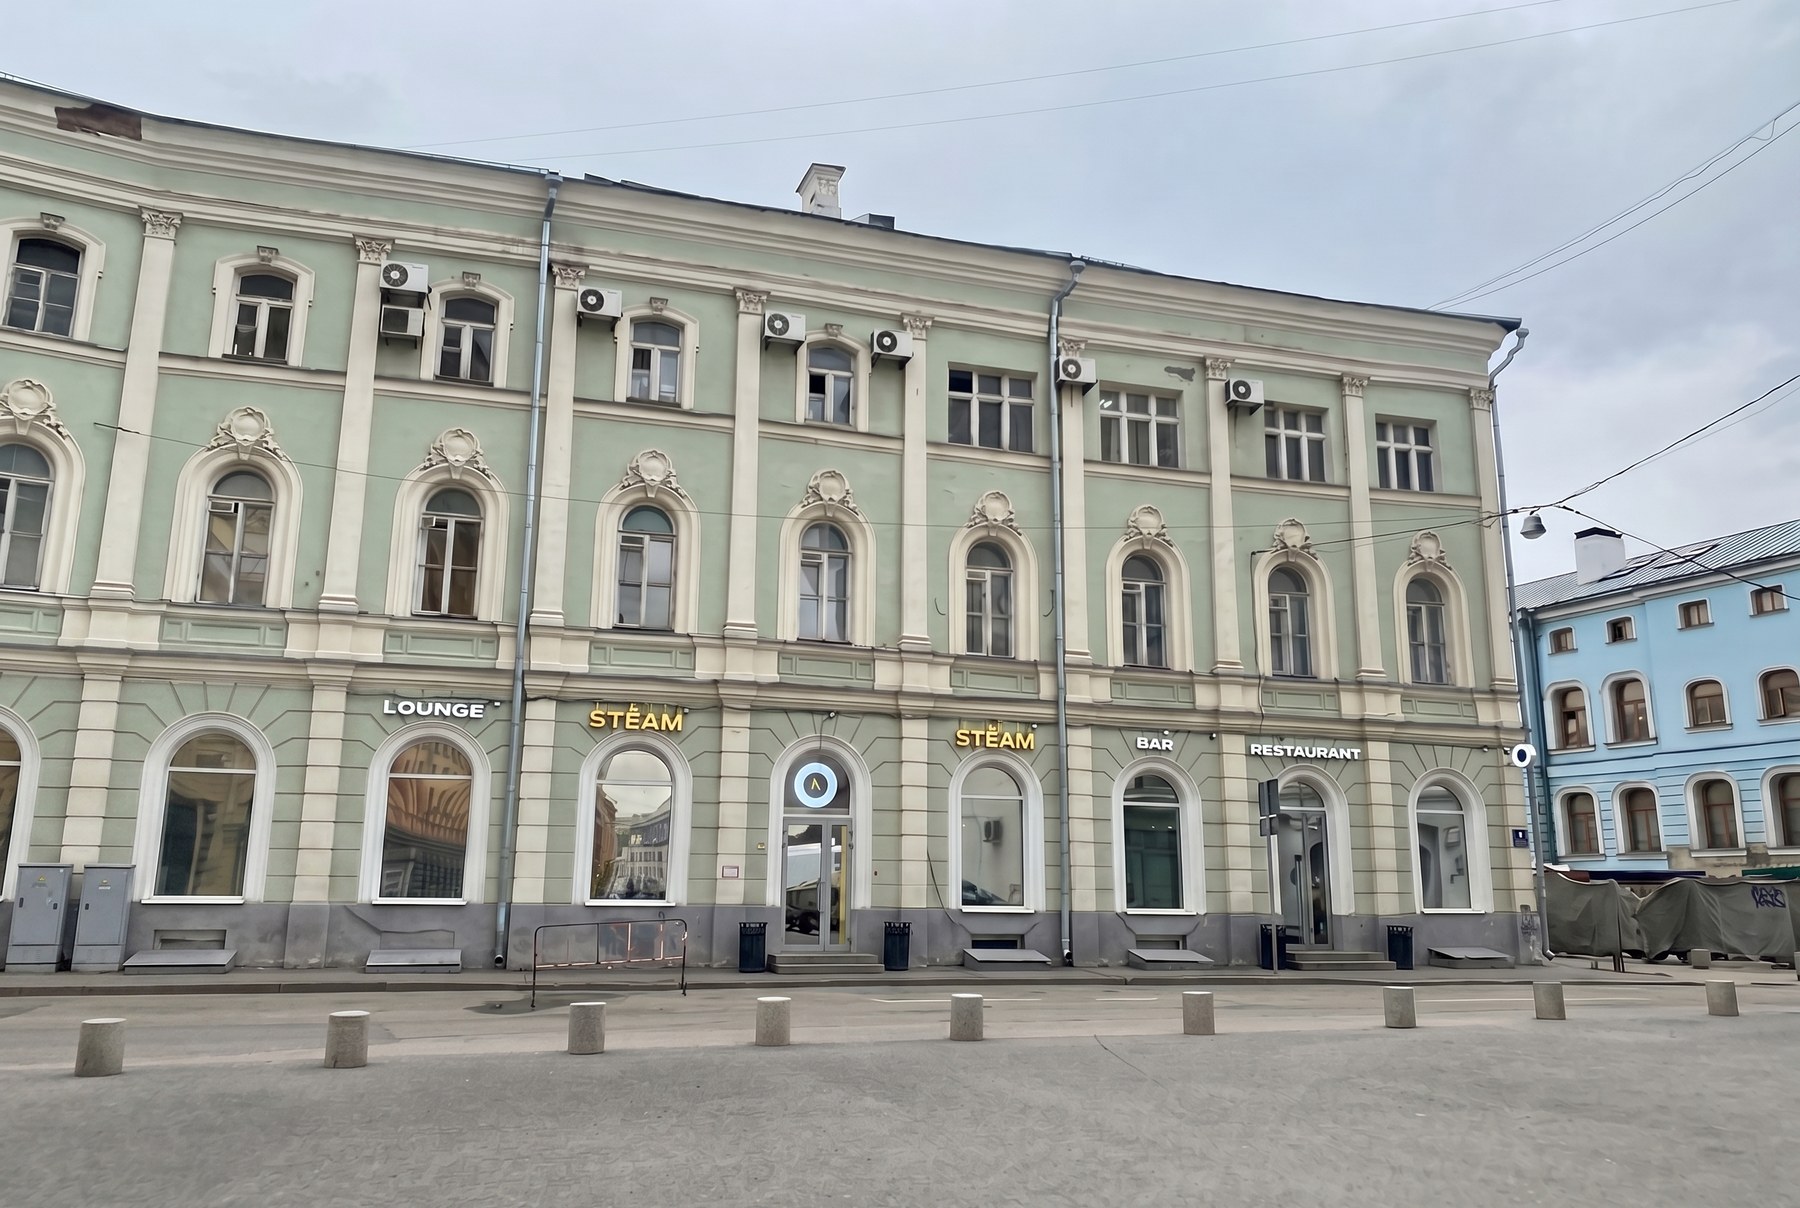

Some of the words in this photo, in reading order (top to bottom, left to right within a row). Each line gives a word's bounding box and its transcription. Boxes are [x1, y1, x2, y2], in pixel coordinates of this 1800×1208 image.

[383, 699, 485, 719] LOUNGE
[1136, 736, 1174, 751] BAR
[1250, 743, 1361, 760] RESTAURANT
